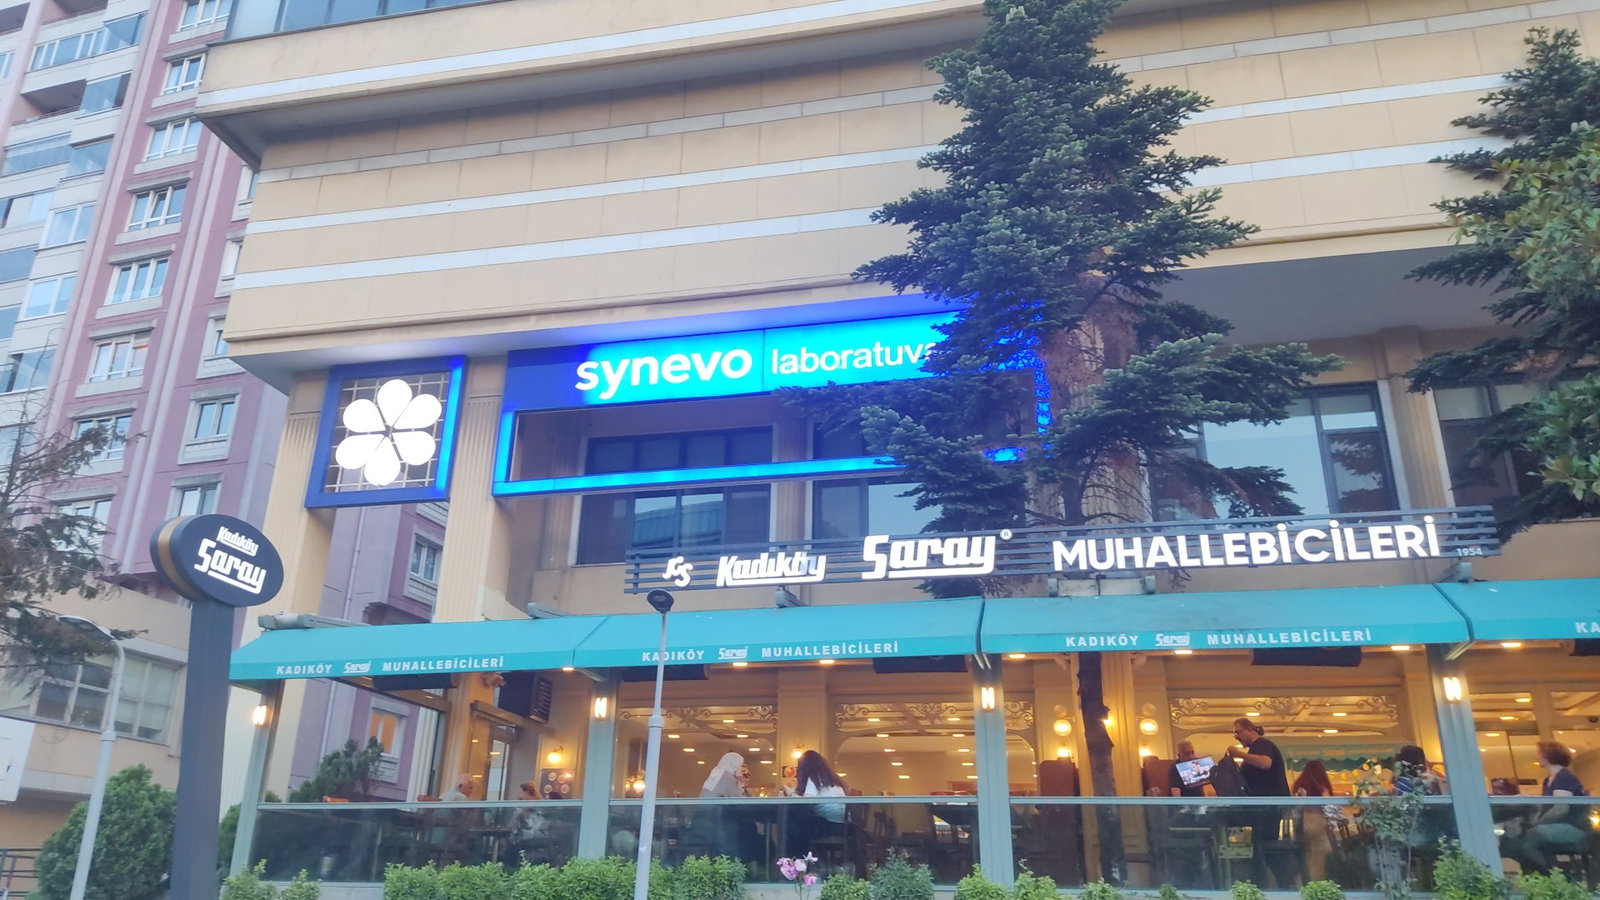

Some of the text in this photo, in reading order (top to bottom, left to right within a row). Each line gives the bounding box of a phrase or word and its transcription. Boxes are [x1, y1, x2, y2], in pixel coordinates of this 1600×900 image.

[574, 347, 753, 400] synevo
[861, 534, 997, 580] Saray
[1052, 515, 1441, 572] MUHALLEBİCİLERİ
[193, 537, 267, 595] Saray
[761, 640, 899, 658] MUHALLEBİCİLERİ
[1066, 633, 1139, 647] KADIKÖY
[1206, 628, 1372, 645] MUHALLEBİCİLERİ
[276, 662, 333, 675] KADIKÖY
[382, 655, 505, 672] MUHALLEBİCİLERİ
